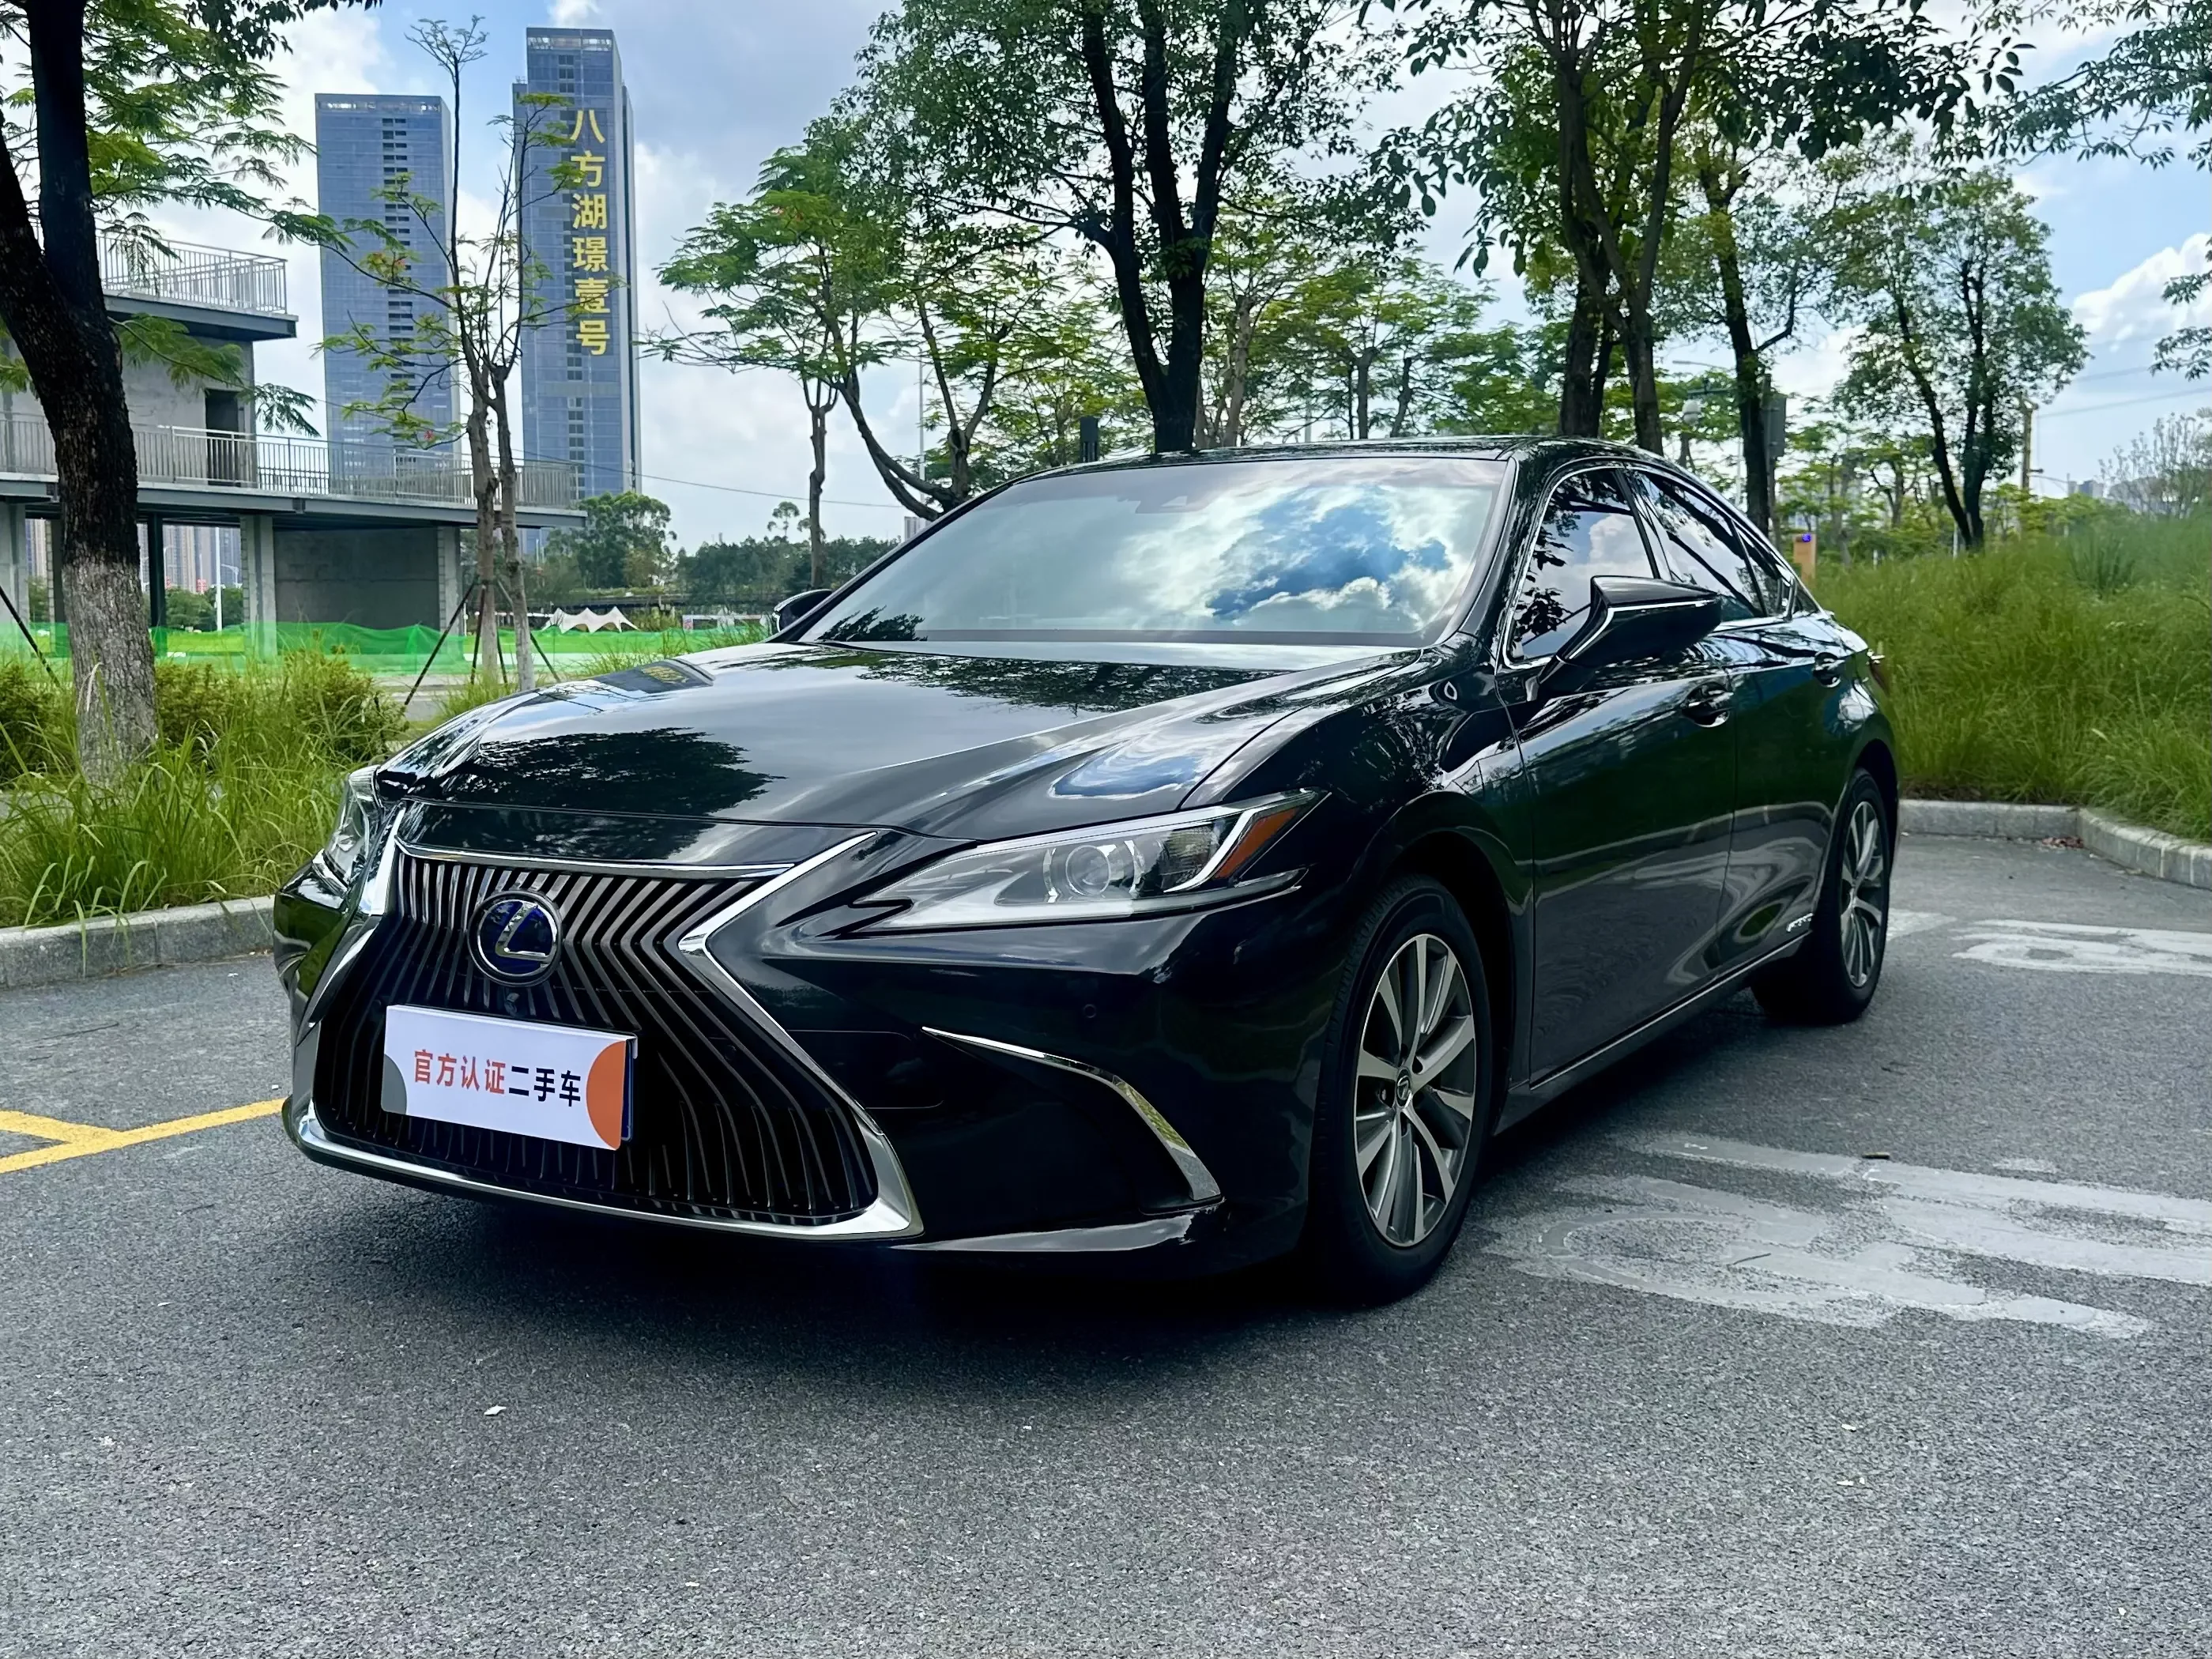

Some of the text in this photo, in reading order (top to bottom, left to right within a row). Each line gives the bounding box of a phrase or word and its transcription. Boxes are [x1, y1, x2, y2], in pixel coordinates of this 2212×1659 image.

[570, 109, 611, 356] 八方湖璟壹号
[413, 1049, 581, 1107] 官方认证二手车
